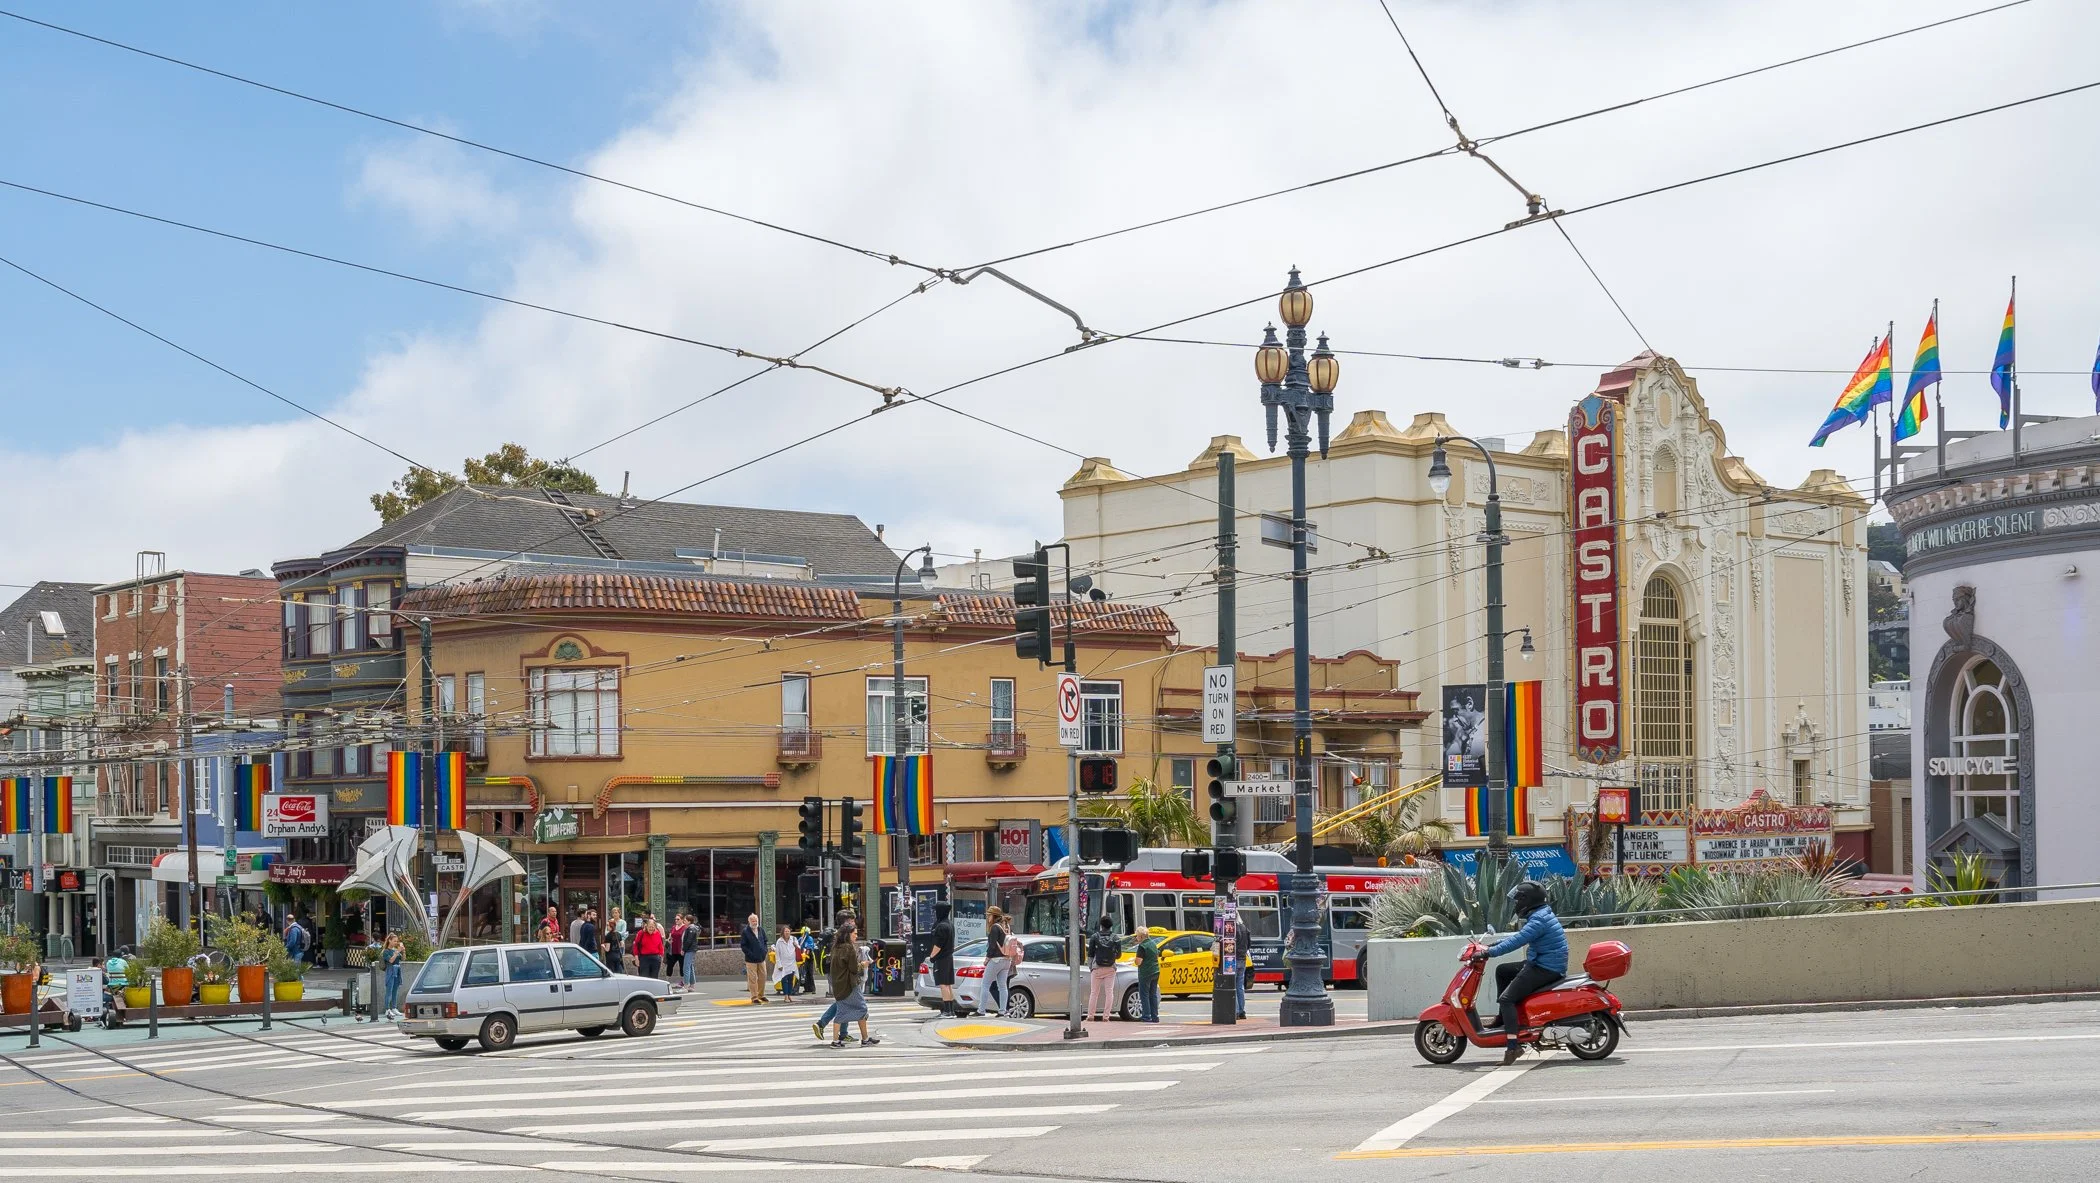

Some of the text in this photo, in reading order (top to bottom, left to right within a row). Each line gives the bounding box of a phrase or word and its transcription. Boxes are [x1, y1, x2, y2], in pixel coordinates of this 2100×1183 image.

[1928, 528, 1945, 548] WILL
[1947, 520, 1976, 545] NEVER
[1979, 517, 1993, 538] BE
[1994, 510, 2036, 537] SILENT
[1577, 433, 1614, 739] CASTRO
[1210, 674, 1227, 688] NO
[1208, 692, 1228, 704] TURN
[1212, 708, 1224, 719] ON
[1061, 728, 1080, 739] ON RED
[1210, 724, 1226, 734] RED
[1929, 756, 2017, 776] SOULCYCLE
[1237, 784, 1280, 793] Market
[282, 800, 312, 812] Coca-Cola
[266, 808, 278, 817] 24
[1744, 814, 1785, 828] CASTRO
[268, 822, 326, 835] Orphan Andy's
[1001, 830, 1029, 845] HOT
[1522, 850, 1561, 860] COMPANY
[1740, 849, 1750, 858] AUG
[288, 866, 306, 879] Andy's
[963, 920, 982, 928] Cancer
[1170, 967, 1214, 984] 333-3333
